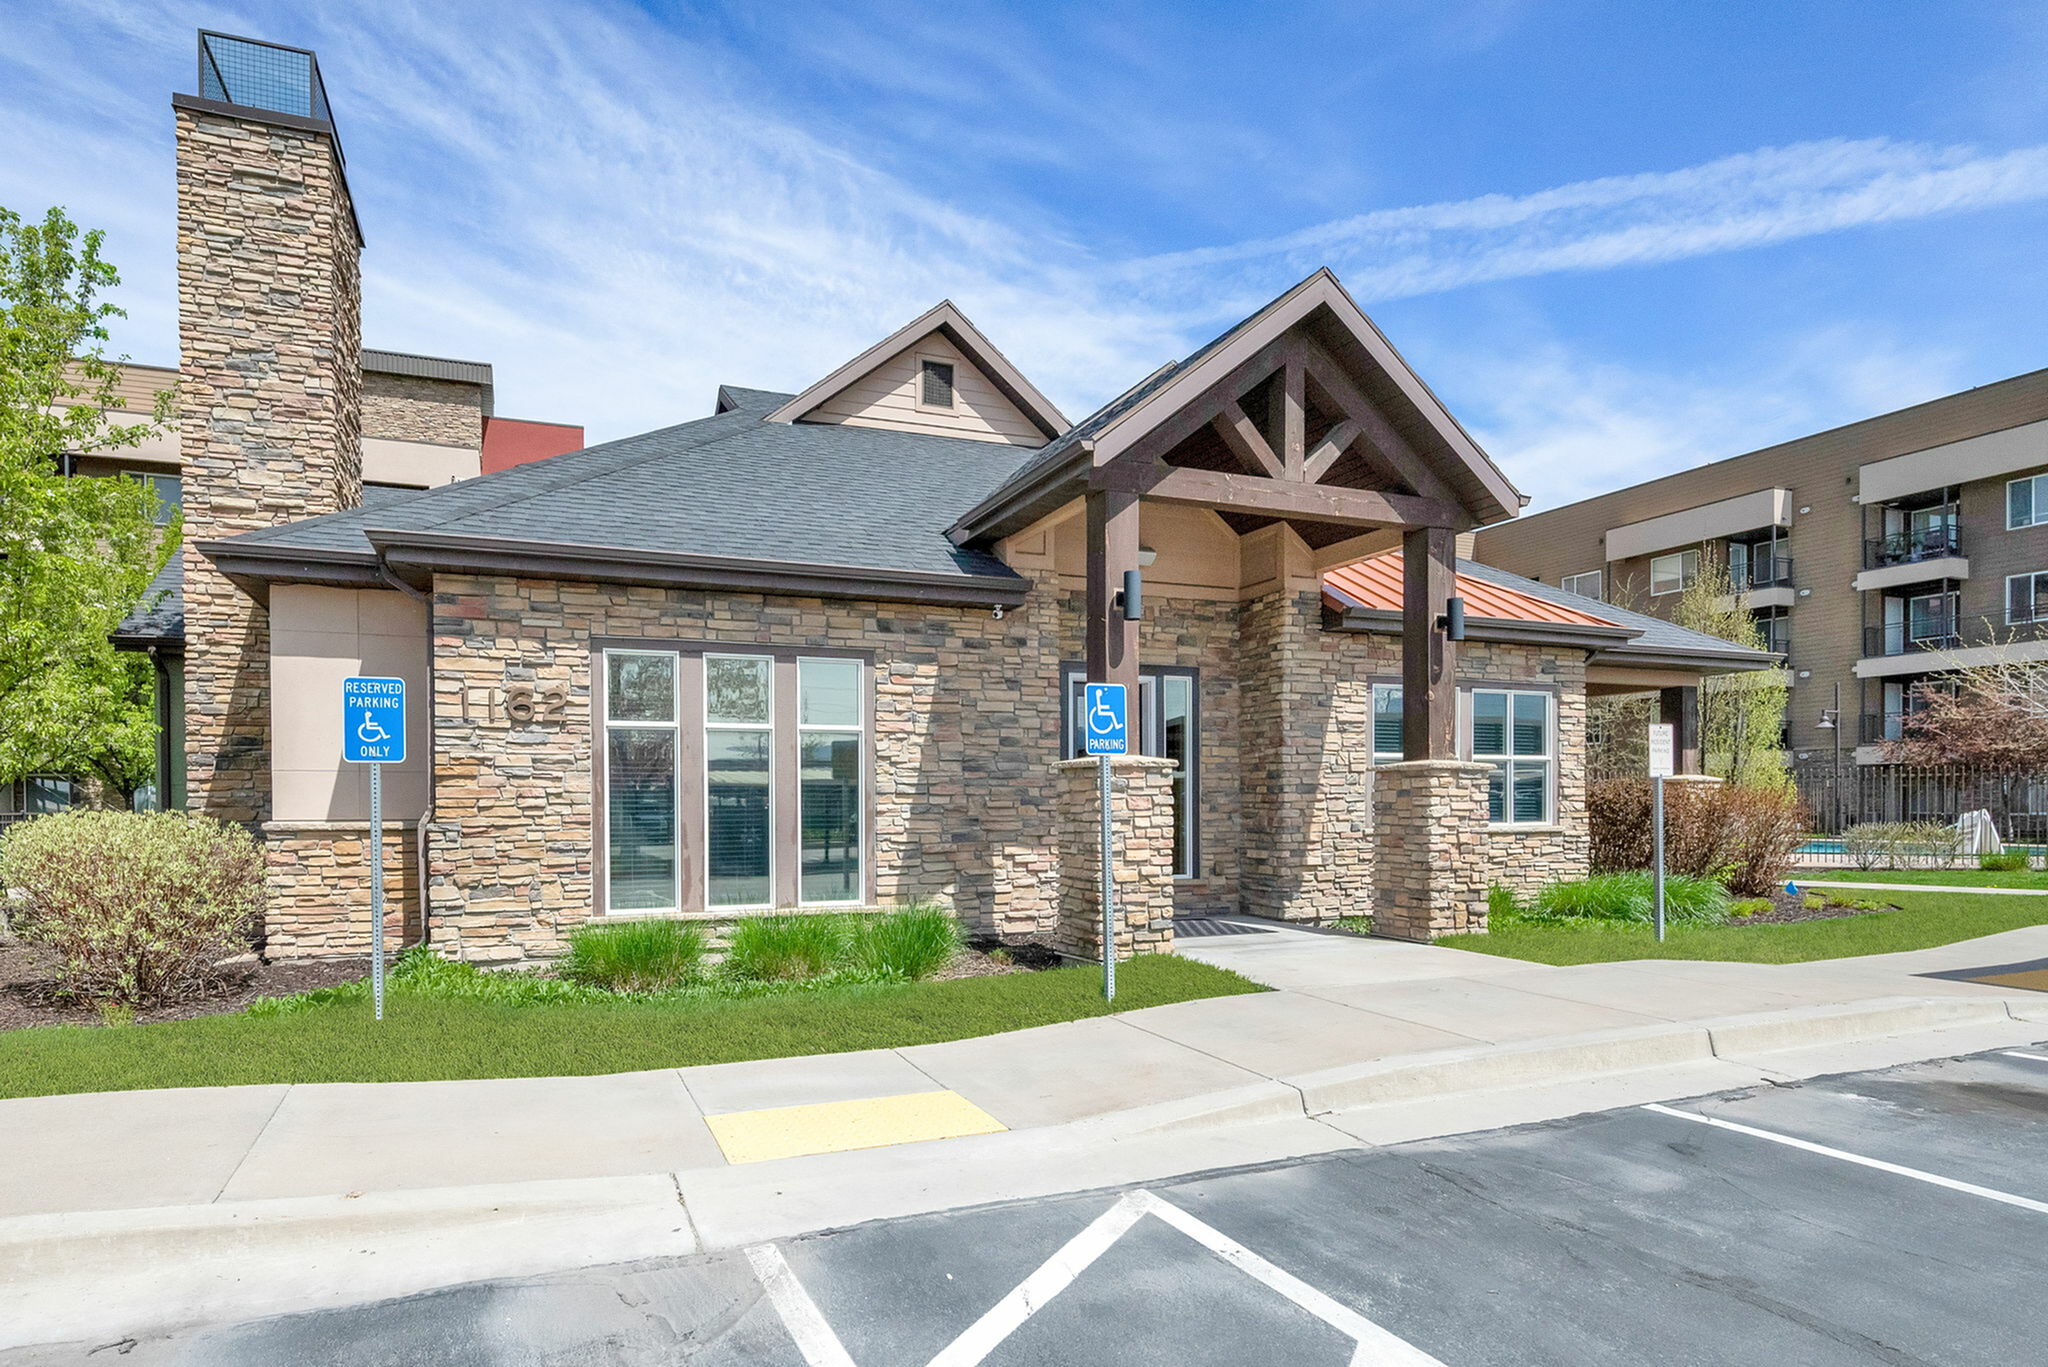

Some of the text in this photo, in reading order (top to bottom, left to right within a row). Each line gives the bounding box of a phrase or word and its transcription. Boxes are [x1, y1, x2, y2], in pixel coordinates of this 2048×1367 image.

[345, 682, 402, 694] RESERVED
[349, 696, 399, 708] PARKING
[462, 686, 568, 722] 1162
[1089, 738, 1125, 750] PARKING
[360, 745, 390, 757] ONLY
